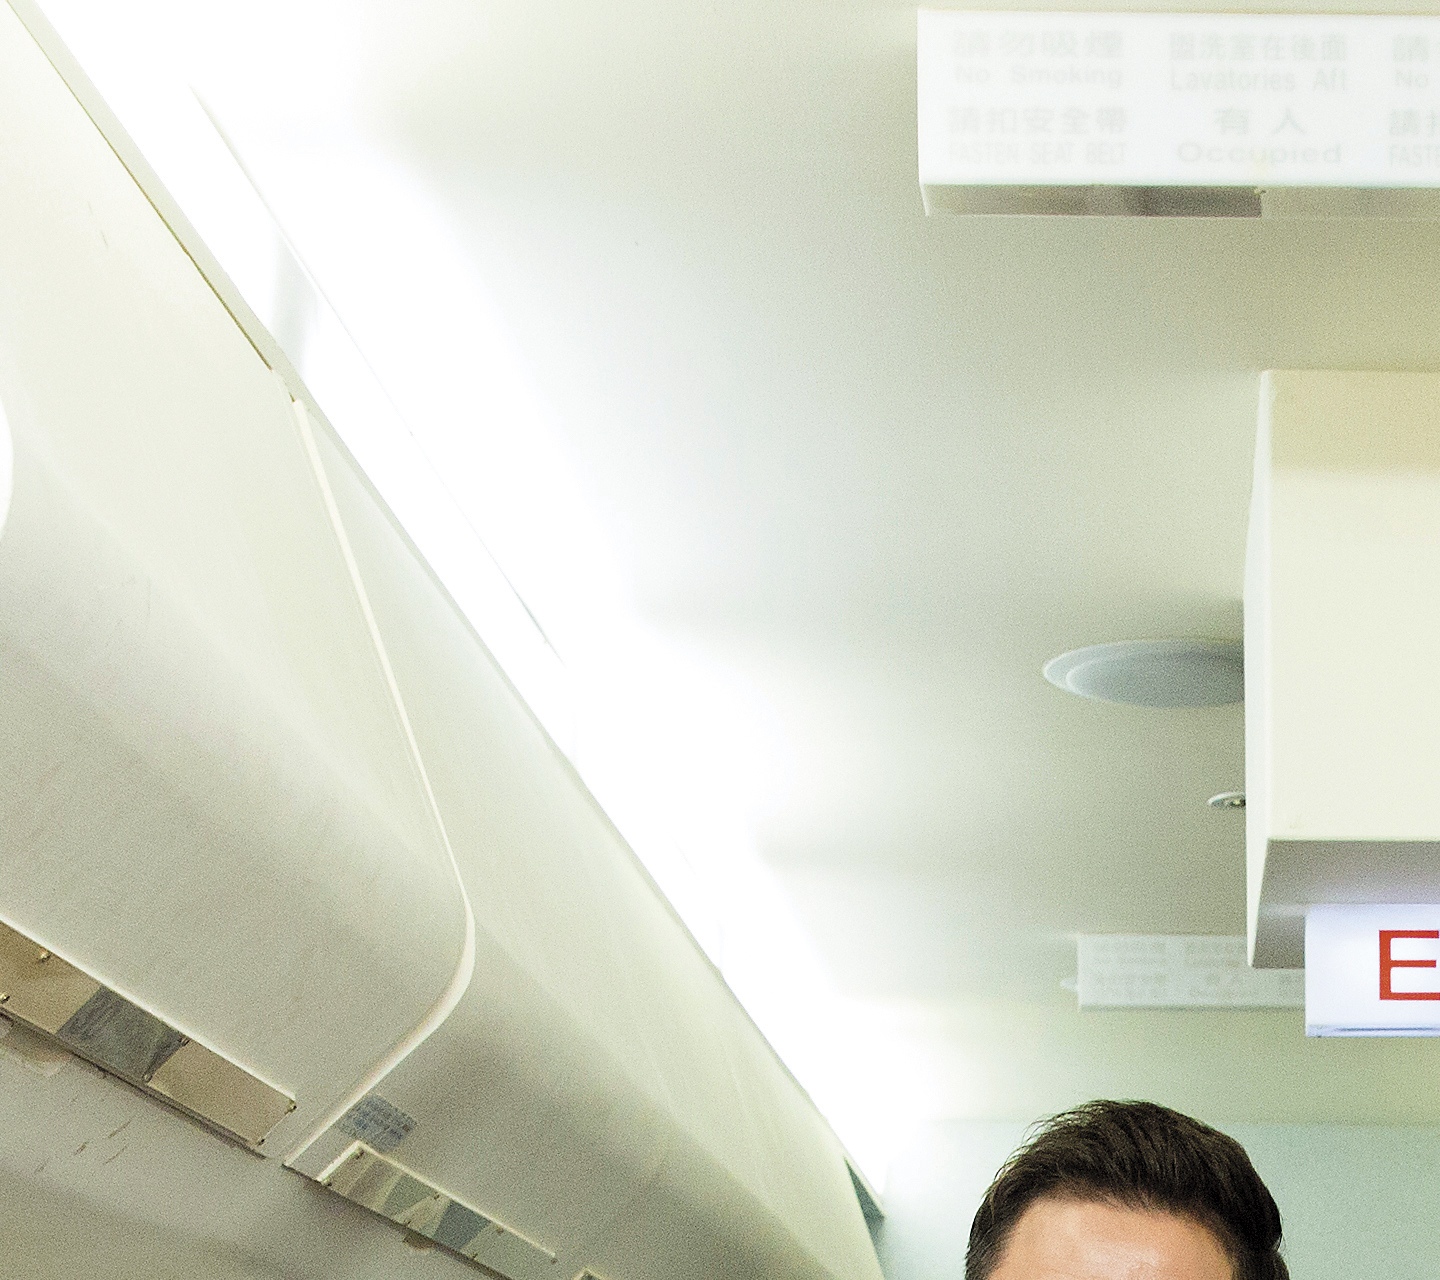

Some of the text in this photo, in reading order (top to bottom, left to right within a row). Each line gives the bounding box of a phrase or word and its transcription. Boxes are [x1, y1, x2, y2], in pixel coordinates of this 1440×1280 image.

[954, 63, 1123, 90] No Smoking
[1170, 64, 1348, 92] Lavatories Aft
[1394, 68, 1430, 89] No
[949, 140, 1127, 166] FASTEN SEAT BELT
[1176, 140, 1343, 167] Occupied
